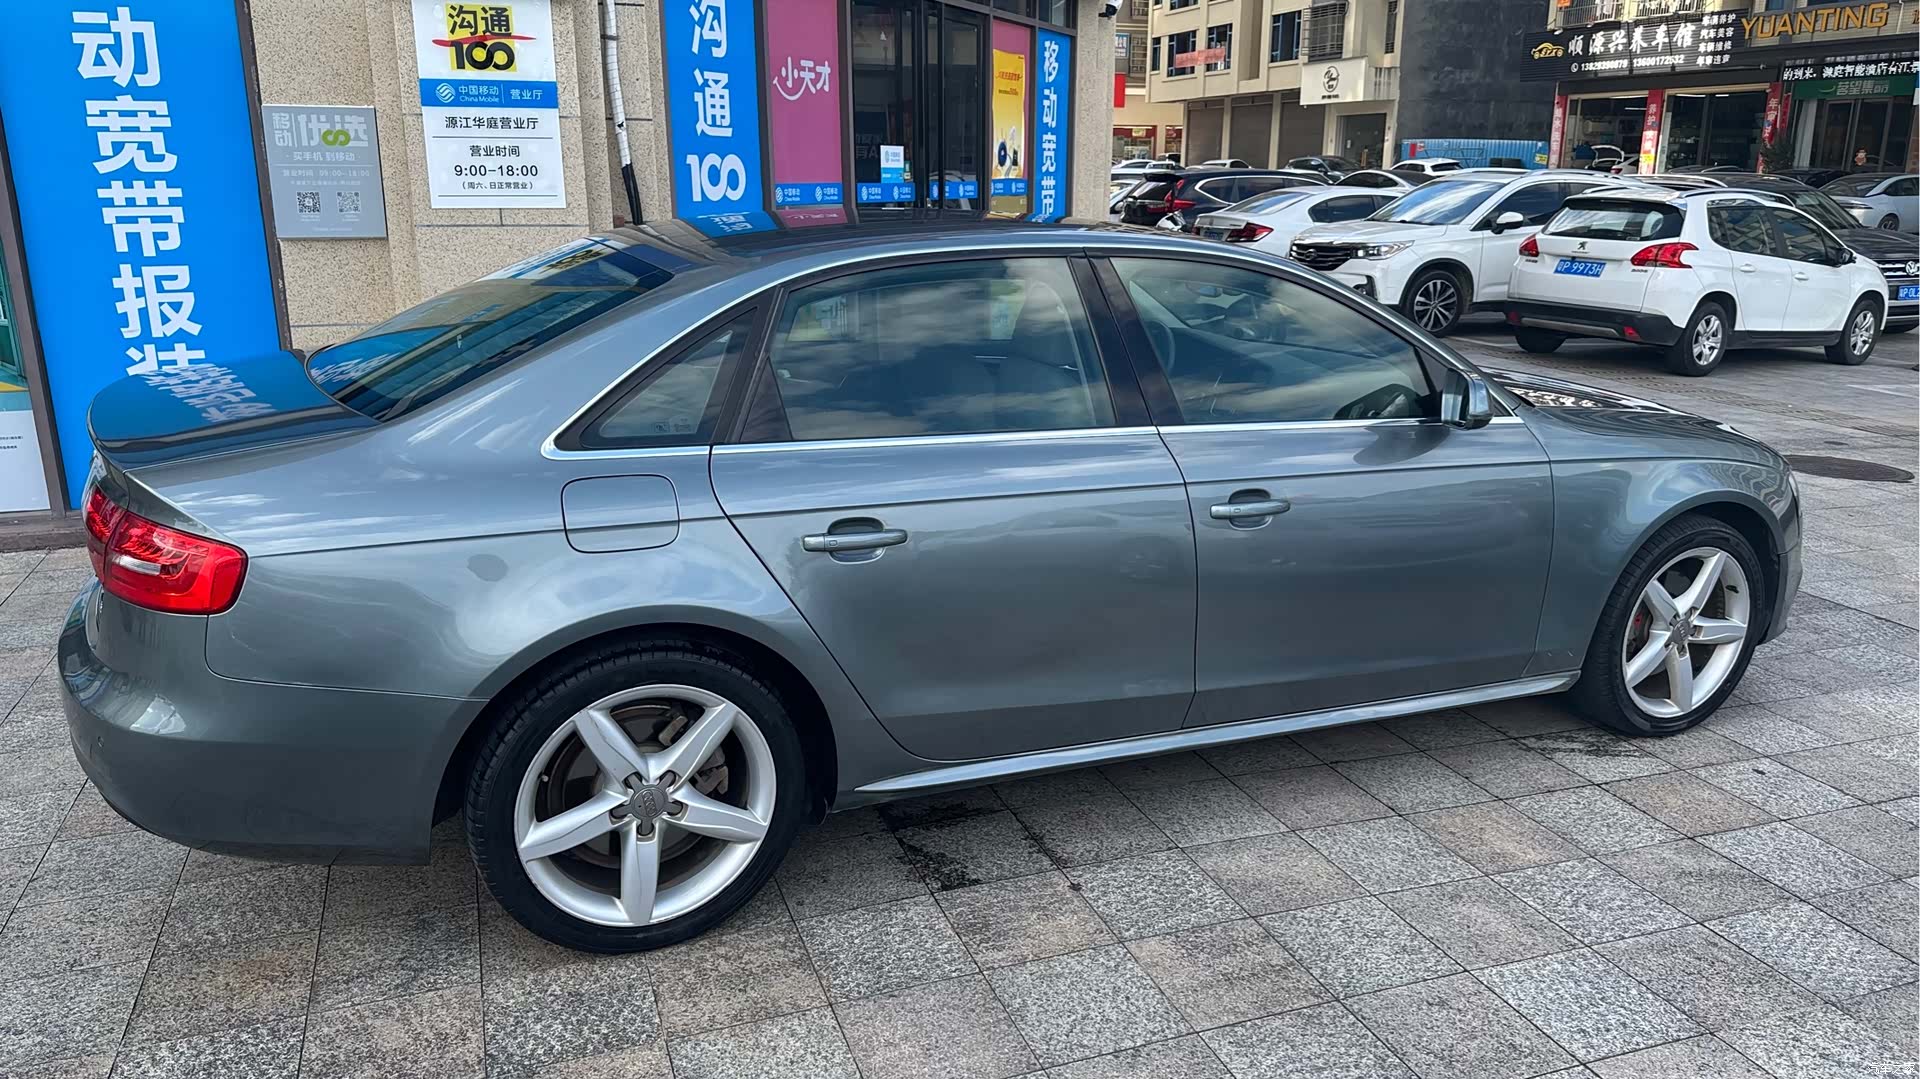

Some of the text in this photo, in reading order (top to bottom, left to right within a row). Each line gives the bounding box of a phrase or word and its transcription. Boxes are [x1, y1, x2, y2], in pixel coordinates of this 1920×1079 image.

[448, 5, 512, 36] 沟通
[1700, 27, 1734, 39] 汽车美容
[1741, 3, 1889, 40] YUANTING
[1568, 23, 1696, 56] 顺源兴养车馆
[451, 41, 516, 71] 100
[458, 85, 543, 100] 中国移动 营业厅
[773, 56, 831, 101] 小天才
[460, 95, 478, 103] China
[272, 112, 292, 147] 移动
[445, 116, 539, 130] 源江华庭营业厅
[1041, 40, 1059, 215] 移动宽带
[470, 145, 520, 157] 营业时间
[454, 165, 538, 177] 9:00-18:00
